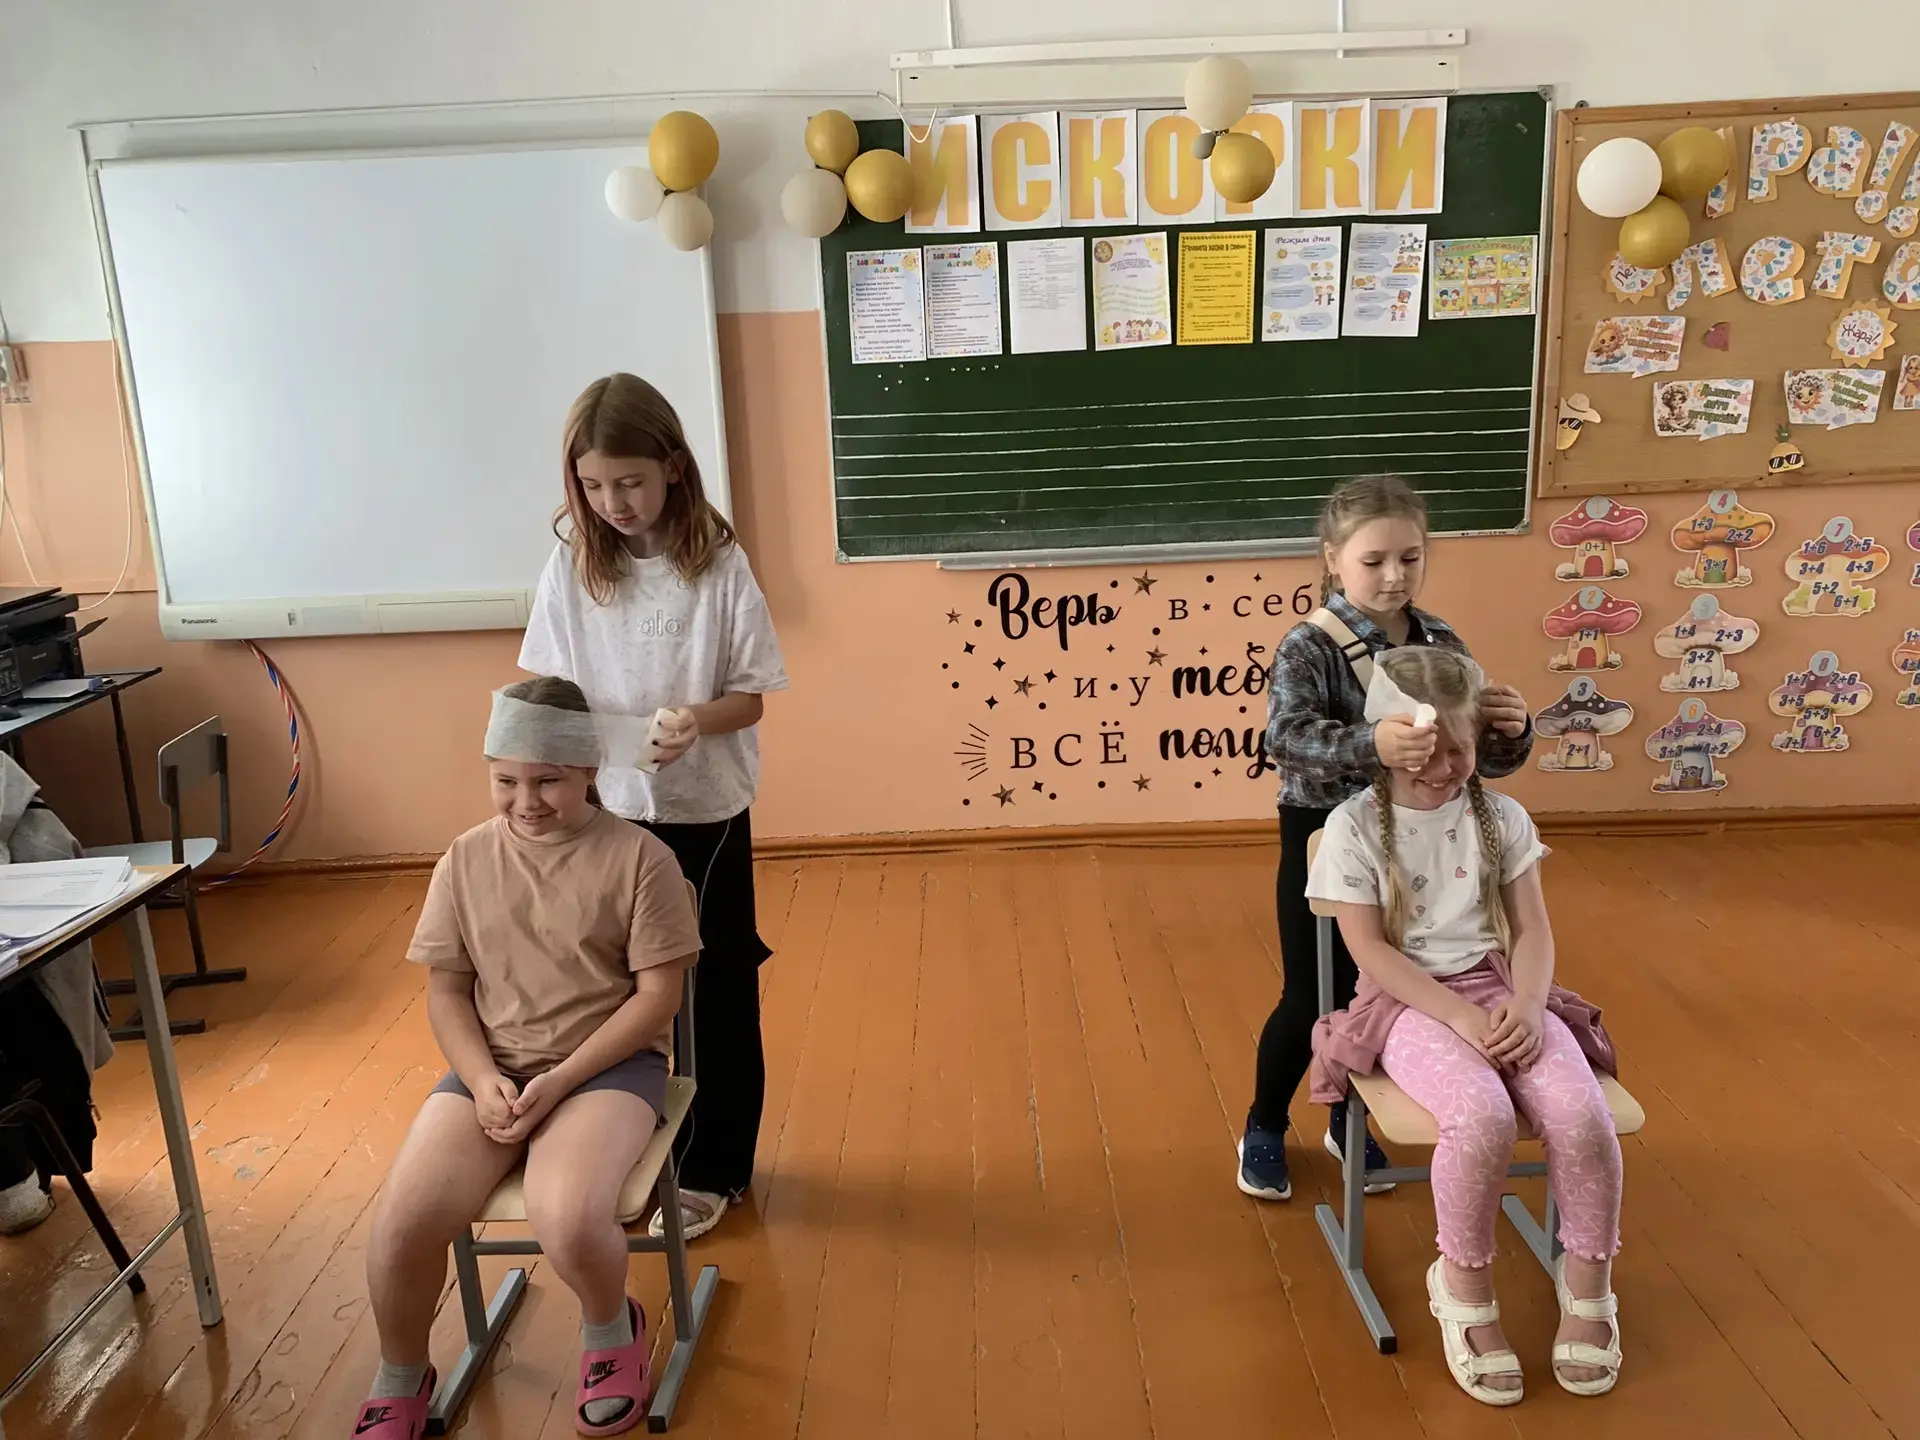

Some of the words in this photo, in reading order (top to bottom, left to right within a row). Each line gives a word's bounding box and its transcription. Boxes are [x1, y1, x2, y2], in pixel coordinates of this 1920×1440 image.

[1275, 236, 1310, 245] Режим
[1312, 234, 1331, 243] дня
[1841, 323, 1881, 346] Жара!
[1717, 493, 1729, 508] 4
[1691, 517, 1715, 532] 1+3
[1834, 523, 1845, 538] 7
[1726, 528, 1754, 543] 2+2
[1584, 541, 1607, 552] 0+1
[1803, 541, 1827, 554] 1+6
[1843, 539, 1872, 553] 2+5
[1703, 558, 1729, 573] 3+1
[1799, 562, 1825, 575] 3+4
[1845, 560, 1874, 573] 4+3
[1812, 581, 1840, 595] 5+2
[1586, 589, 1597, 604] 2
[1833, 594, 1860, 608] 6+1
[987, 572, 1122, 651] Верь
[1168, 598, 1190, 621] в
[1232, 582, 1314, 618] себ
[180, 617, 218, 625] Panasonic
[1578, 628, 1600, 642] 1+1
[1674, 624, 1697, 638] 1+4
[1714, 629, 1744, 642] 2+3
[1687, 650, 1715, 664] 3+2
[1818, 657, 1830, 672] 8
[1074, 676, 1098, 699] и
[1128, 675, 1151, 706] у
[1172, 641, 1272, 699] теб
[1786, 673, 1809, 686] 1+7
[1829, 672, 1858, 685] 2+6
[1687, 675, 1713, 689] 4+1
[1577, 682, 1588, 697] 3
[1778, 694, 1805, 707] 3+5
[1830, 692, 1858, 705] 4+4
[1687, 703, 1699, 719] 6
[1803, 707, 1830, 720] 5+3
[1568, 717, 1593, 731] 1+2
[1696, 722, 1724, 737] 2+4
[1660, 725, 1683, 740] 1+5
[1813, 726, 1841, 740] 6+2
[1010, 720, 1128, 769] ВСЁ
[1159, 726, 1277, 779] полу
[1566, 743, 1591, 757] 2+1
[1702, 741, 1729, 756] 4+2
[1782, 737, 1807, 750] 7+1
[1658, 744, 1684, 759] 3+3
[1680, 766, 1705, 780] 5+1
[588, 1359, 618, 1377] NIKE
[361, 1406, 393, 1423] NIKE
